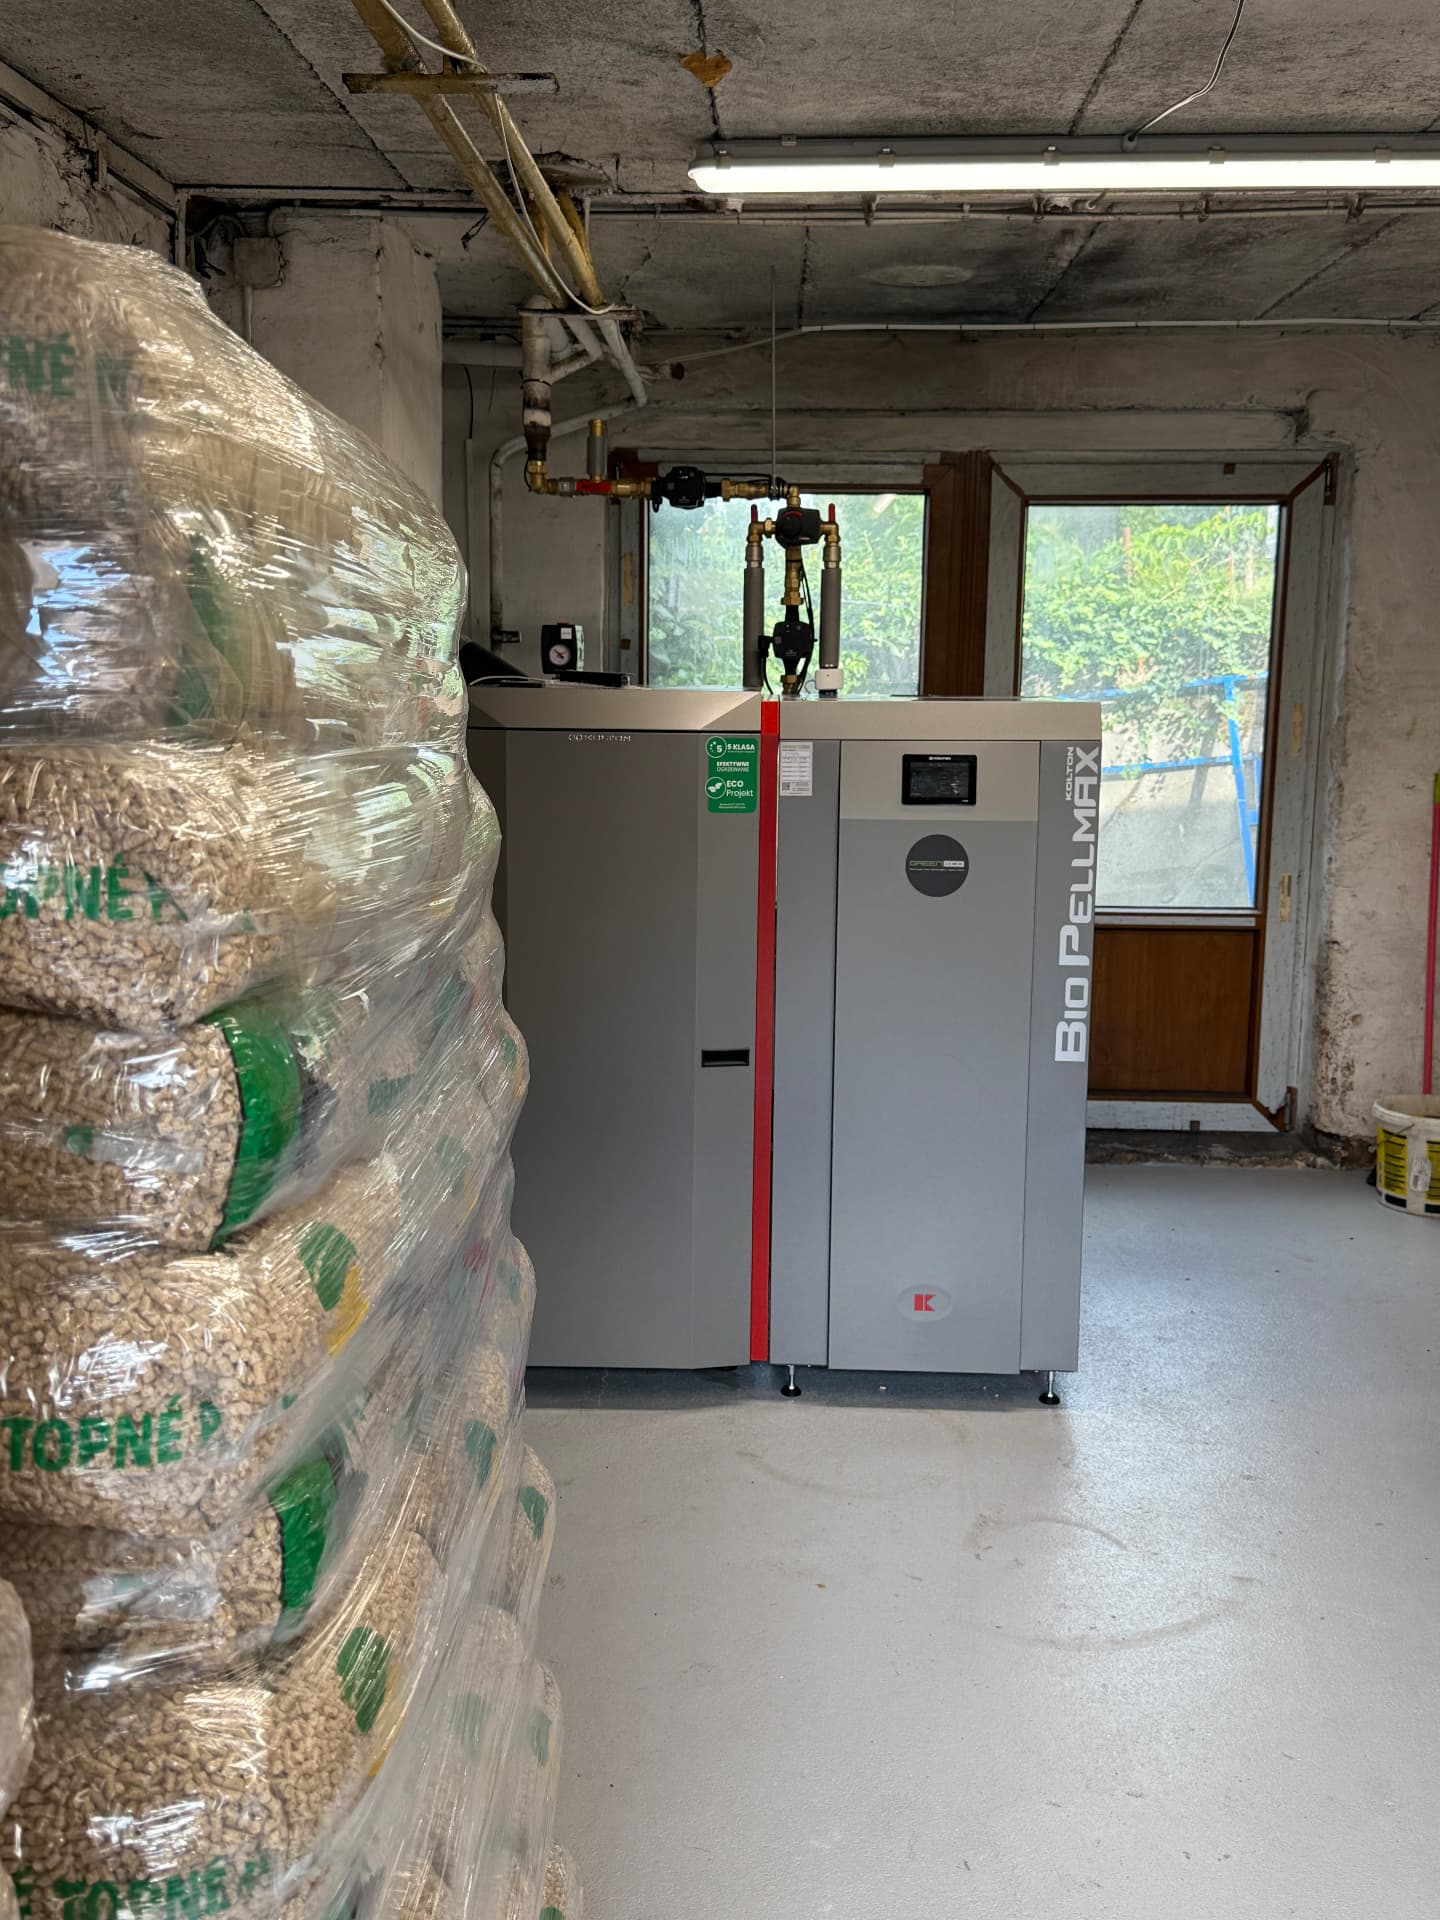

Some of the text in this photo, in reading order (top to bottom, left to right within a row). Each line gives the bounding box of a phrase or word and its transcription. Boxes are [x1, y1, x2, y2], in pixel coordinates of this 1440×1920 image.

[0, 331, 75, 397] NÉ
[732, 743, 755, 751] KLASA
[726, 780, 744, 788] ECO
[1065, 746, 1074, 801] KOLTON
[726, 789, 754, 798] Projekt
[1, 1394, 183, 1472] TOPNÉ
